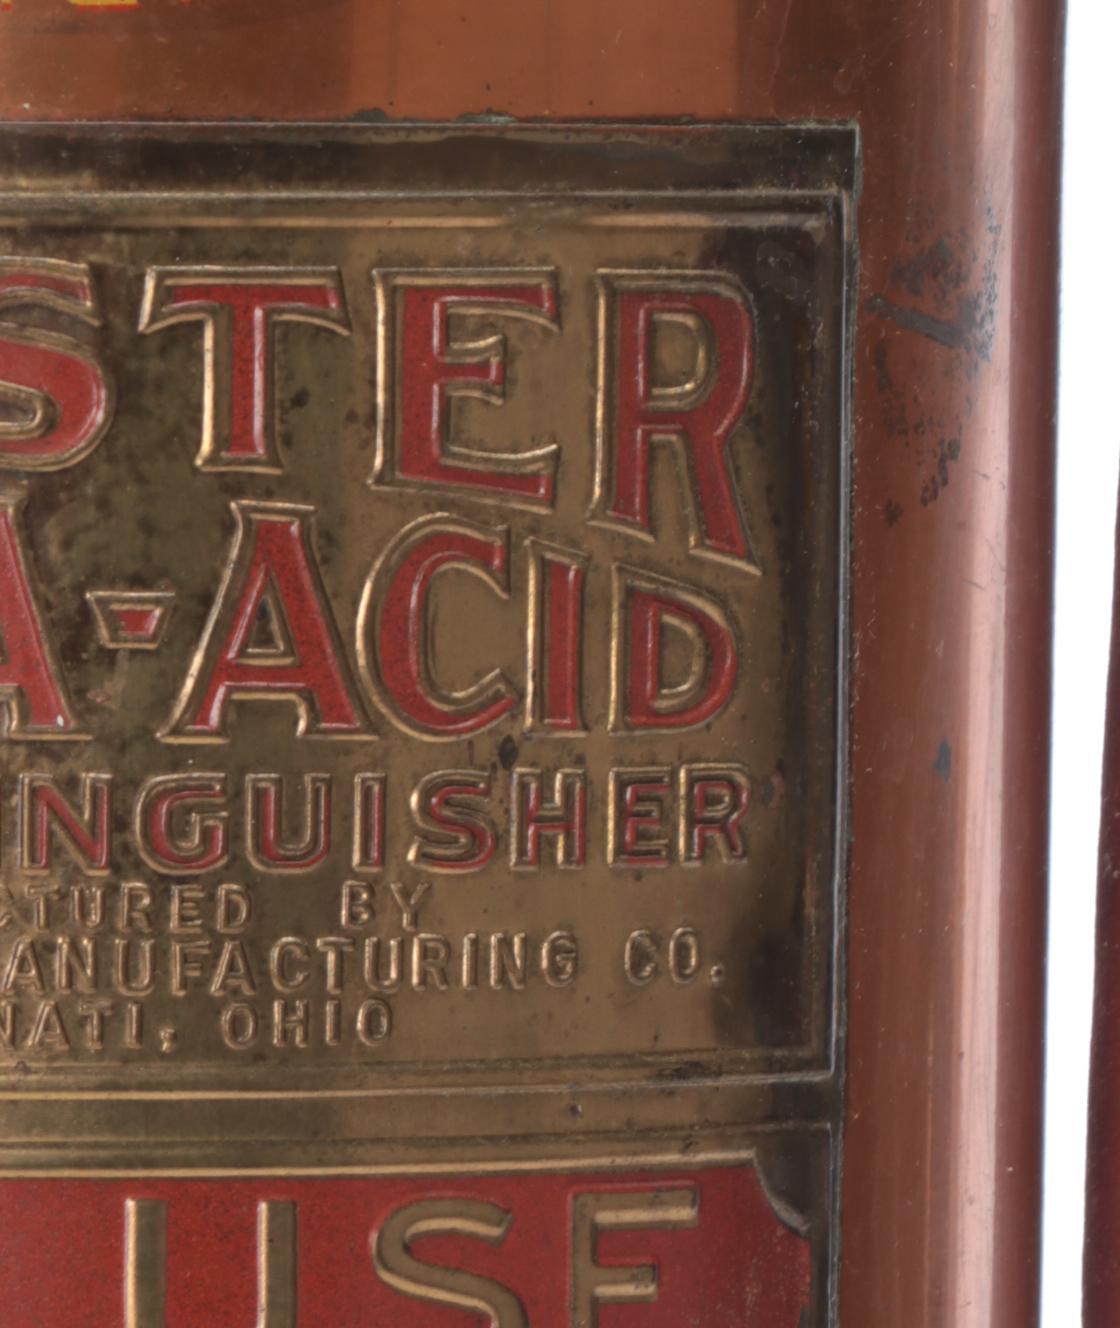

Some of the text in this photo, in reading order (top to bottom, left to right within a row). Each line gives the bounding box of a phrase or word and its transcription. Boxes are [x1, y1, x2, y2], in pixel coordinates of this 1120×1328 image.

[339, 881, 435, 932] BY
[622, 926, 726, 985] CO.
[219, 999, 393, 1049] OHIO
